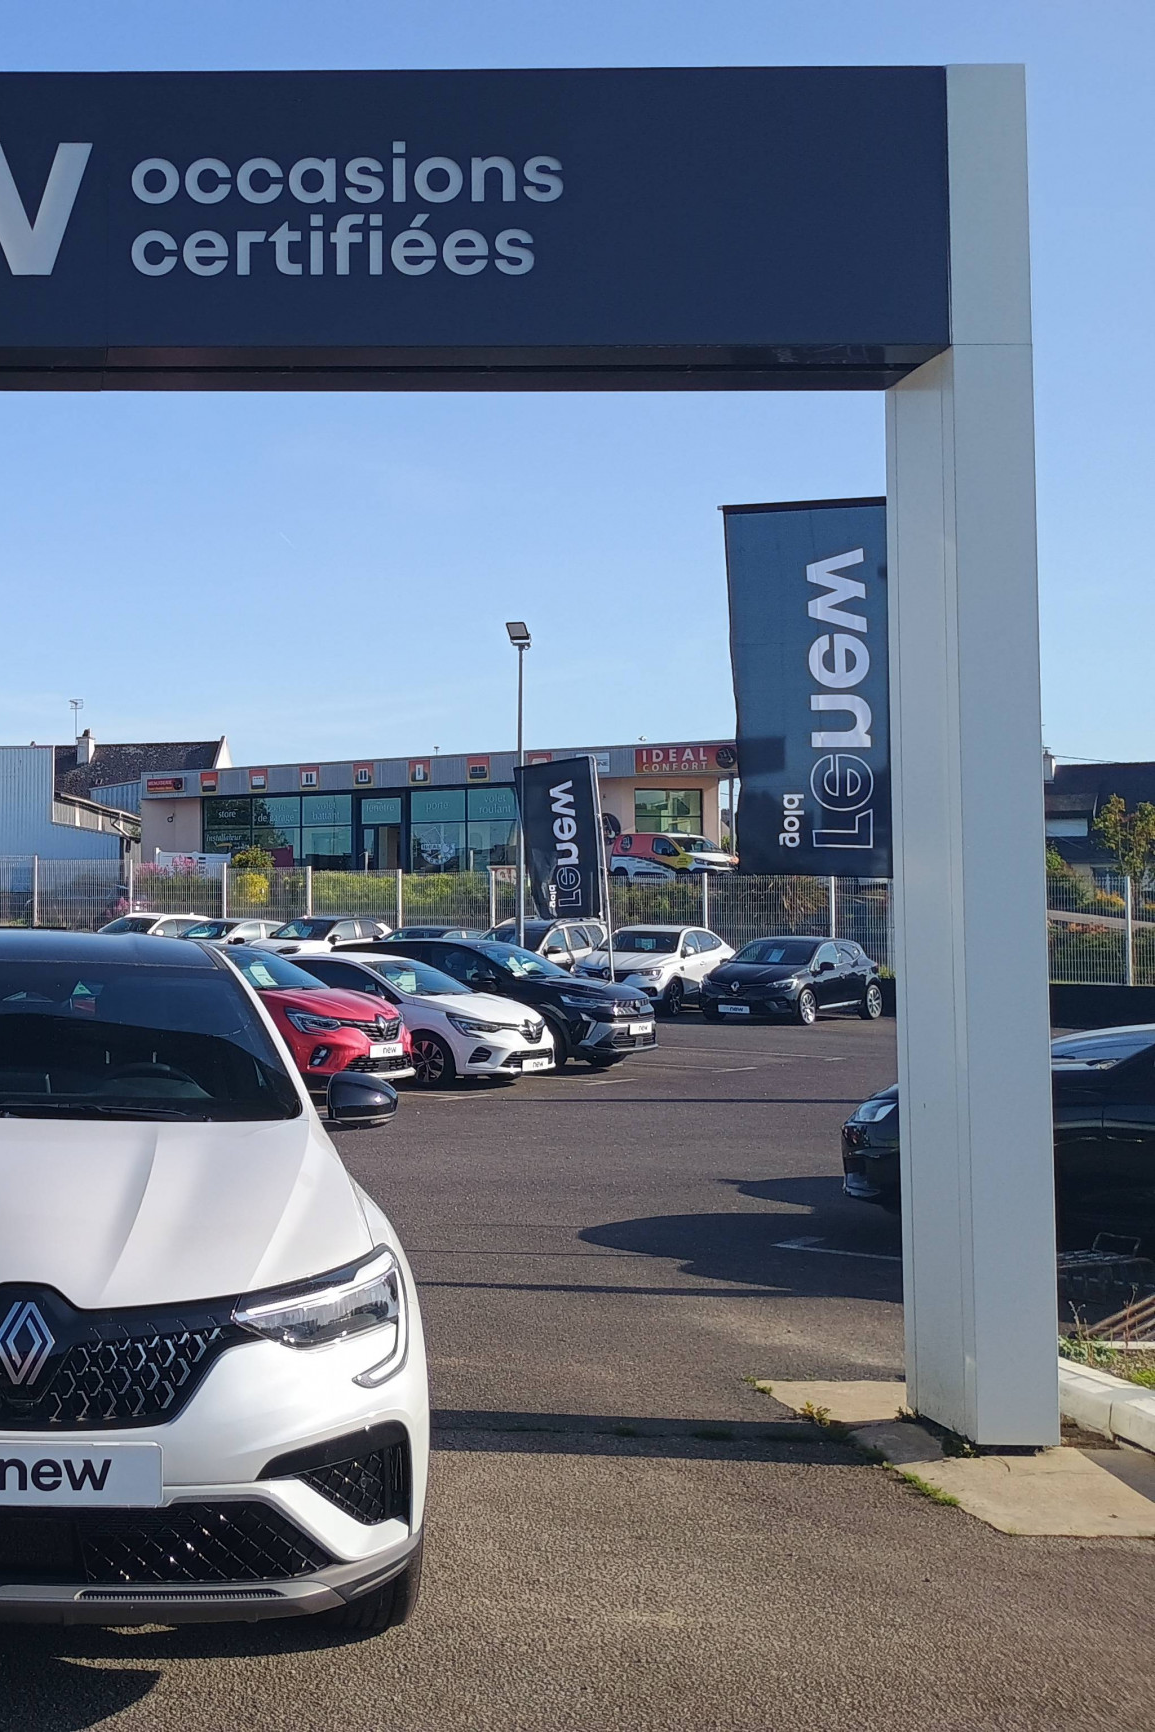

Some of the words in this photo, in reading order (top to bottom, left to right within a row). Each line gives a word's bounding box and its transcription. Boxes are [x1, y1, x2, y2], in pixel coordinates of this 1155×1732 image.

[131, 141, 563, 204] occasions
[131, 212, 535, 276] certifiées
[642, 747, 708, 763] IDEAL
[642, 761, 708, 772] CONFORT
[484, 793, 506, 802] volet
[316, 799, 337, 810] volet
[425, 800, 449, 812] porte
[478, 803, 512, 814] roulant
[218, 809, 237, 819] store
[257, 813, 268, 823] de
[269, 813, 295, 825] garage
[312, 811, 341, 820] battant
